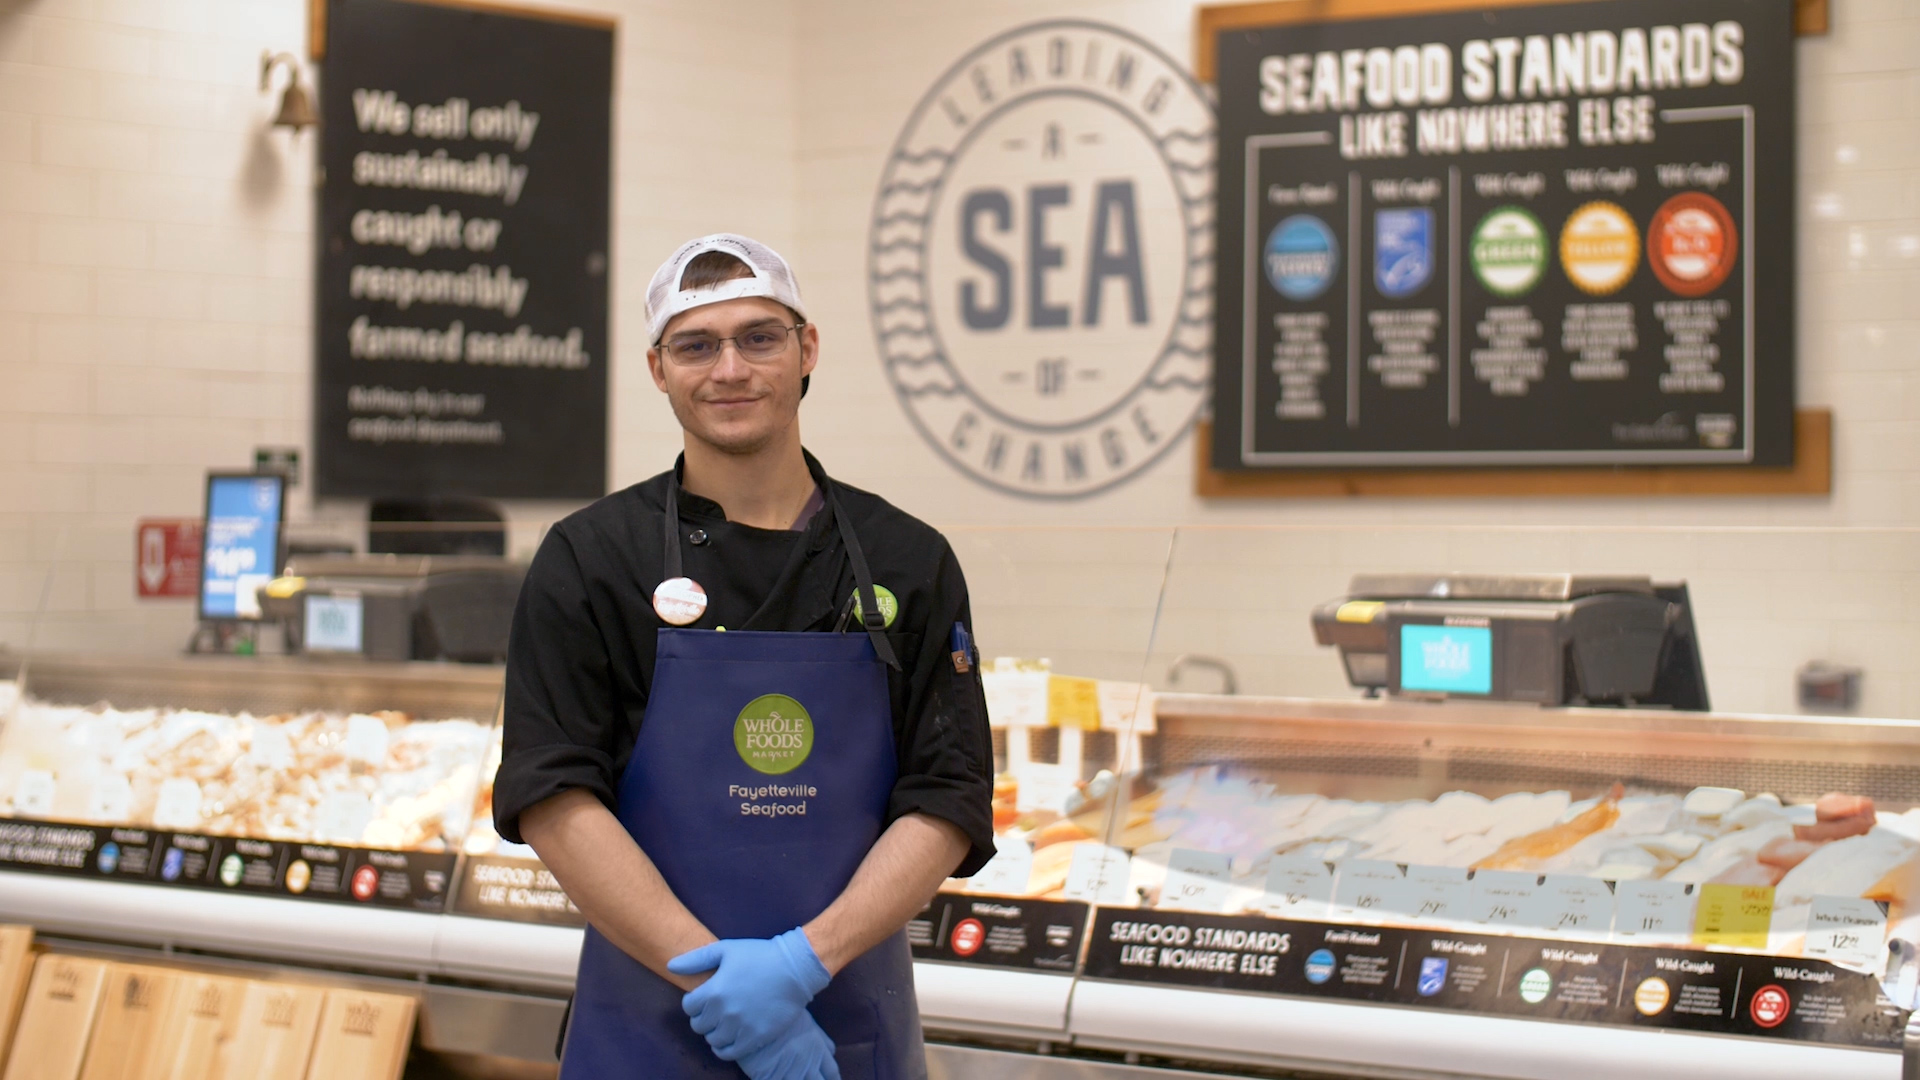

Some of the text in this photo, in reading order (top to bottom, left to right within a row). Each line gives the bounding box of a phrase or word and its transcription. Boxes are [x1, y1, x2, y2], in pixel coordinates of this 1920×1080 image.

[941, 38, 1172, 127] LEADING
[1259, 21, 1745, 115] SEAFOOD STANDARDS
[353, 88, 540, 151] We sell only
[1340, 97, 1655, 160] LIKE NOWHERE ELSE
[1043, 123, 1064, 159] A
[353, 149, 528, 205] sustainably
[351, 204, 501, 255] caught or
[957, 180, 1150, 332] SEA
[350, 264, 529, 317] responsibly
[348, 316, 590, 369] farmed seafood.
[1036, 357, 1067, 396] OF
[951, 404, 1161, 483] CHANGE
[742, 717, 804, 733] WHOLE
[746, 734, 803, 749] FOODS
[752, 751, 795, 762] MARKET
[729, 785, 817, 800] Fayetteville
[740, 801, 806, 817] Seafood
[473, 865, 535, 888] SEAFOOD
[1110, 921, 1291, 954] SEAFOOD STANDARDS
[1120, 945, 1279, 976] LIKE NOWHERE ELSE
[1541, 948, 1599, 965] Wild-Caught
[1656, 957, 1715, 975] Wild-Caught
[1774, 966, 1835, 984] Wild-Caught
